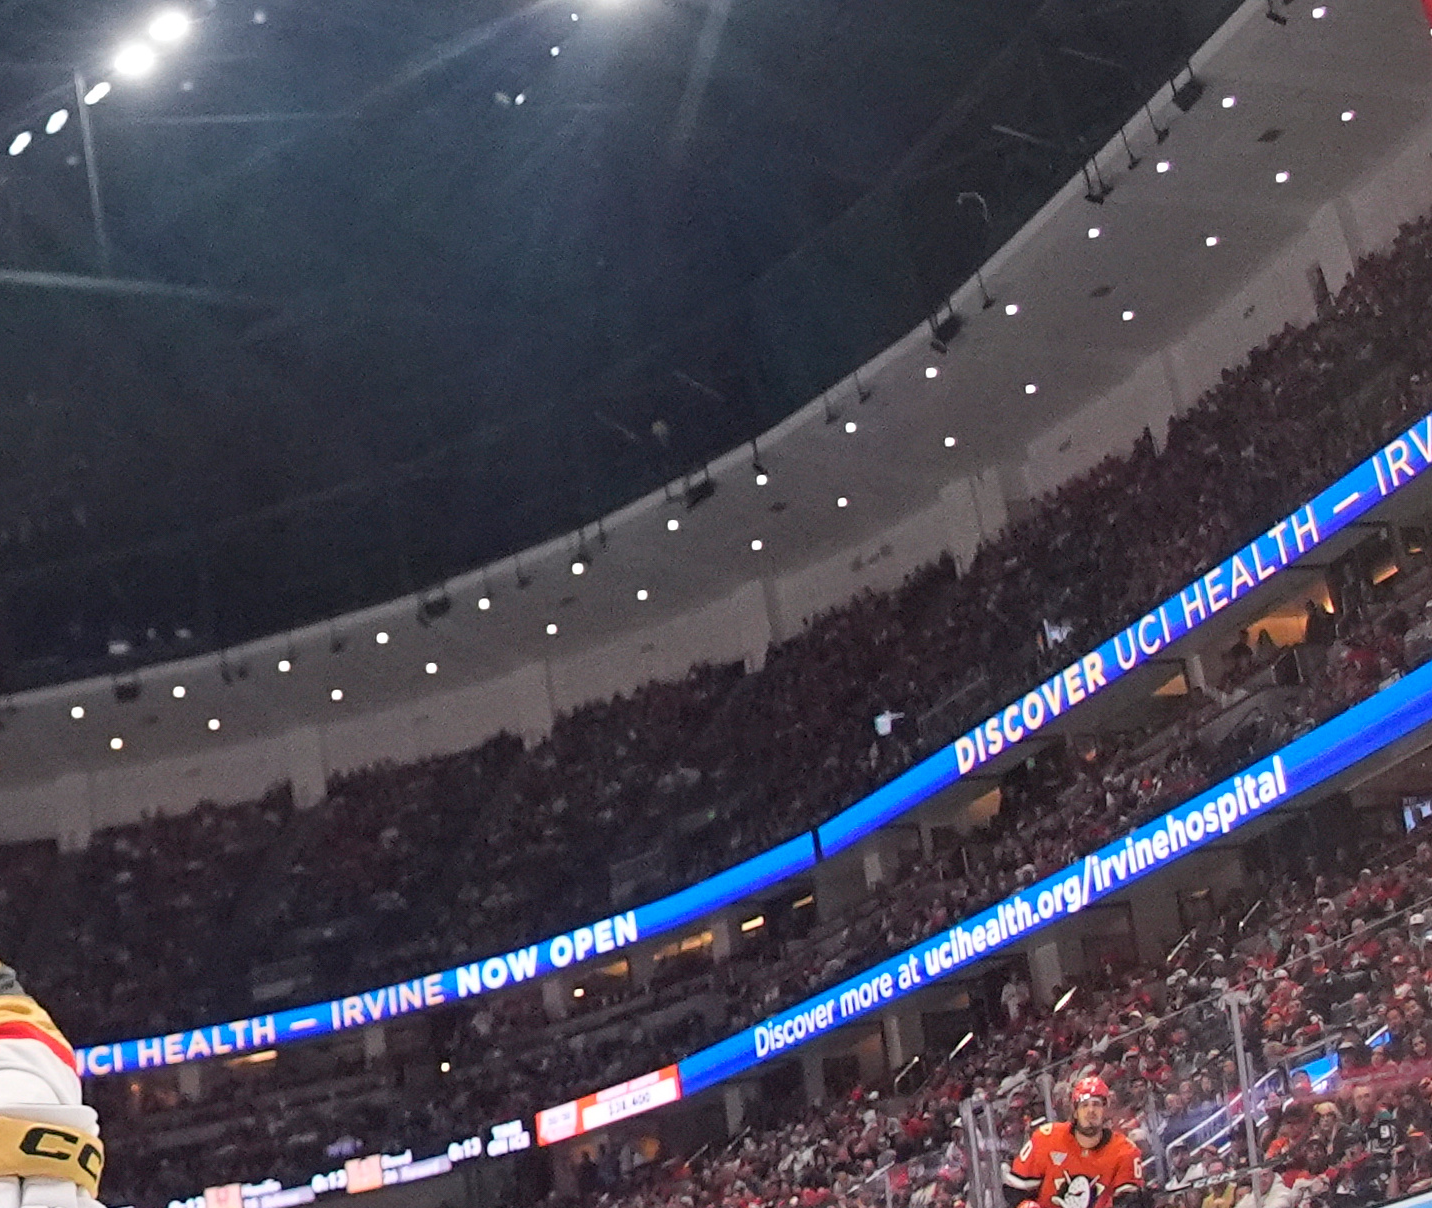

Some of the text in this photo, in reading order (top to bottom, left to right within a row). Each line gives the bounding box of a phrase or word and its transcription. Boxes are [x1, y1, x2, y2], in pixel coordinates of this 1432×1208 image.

[953, 651, 1106, 776] DISCOVER
[1115, 622, 1174, 671] UCI
[1180, 504, 1321, 630] HEALTH
[137, 1015, 277, 1070] HEALTH
[330, 973, 446, 1032] IRVINE
[456, 944, 539, 997] NOW
[549, 910, 639, 970] OPEN
[753, 754, 1288, 1059] Discover more at ucihealth.org/irvinehospital
[18, 1127, 103, 1184] CC
